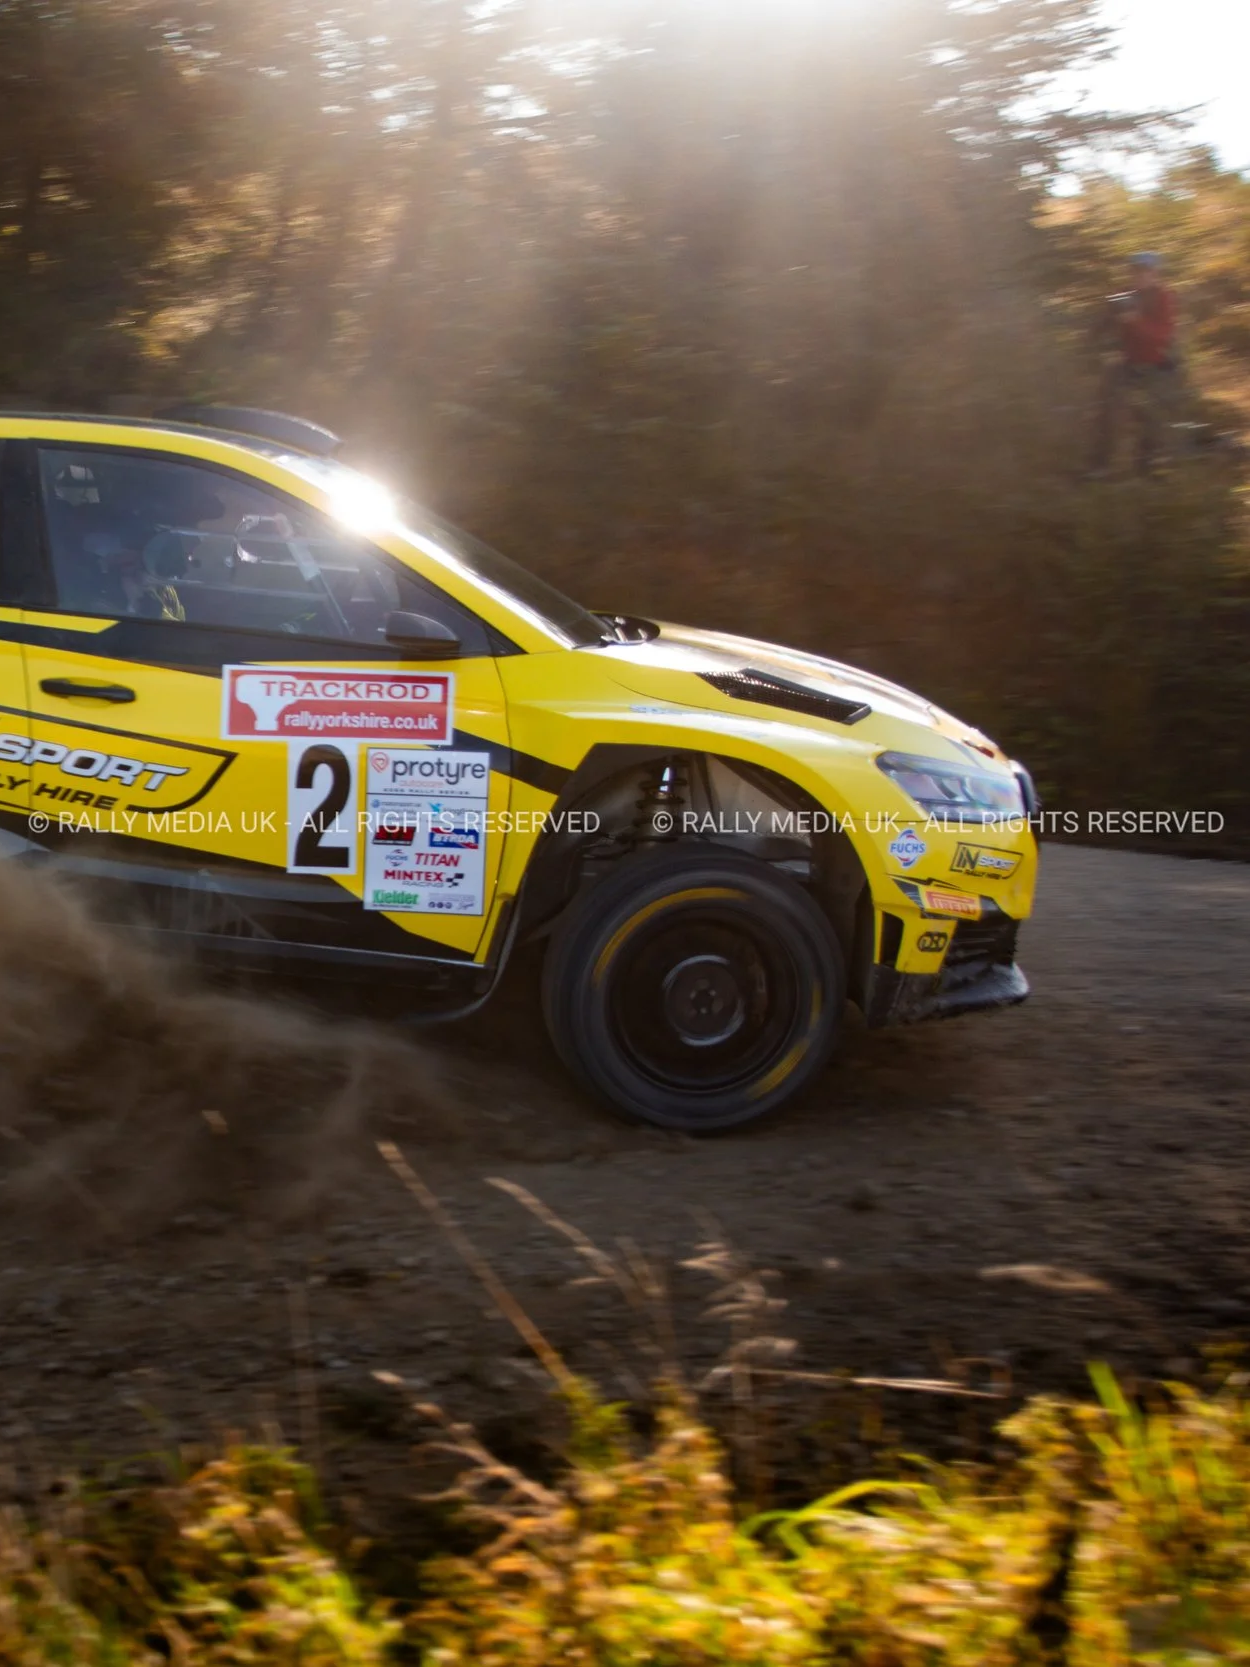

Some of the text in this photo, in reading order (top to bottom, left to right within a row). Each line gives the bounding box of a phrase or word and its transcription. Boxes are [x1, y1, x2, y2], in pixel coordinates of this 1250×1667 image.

[259, 680, 430, 700] TRACKROD
[284, 711, 438, 731] rallyyorkshire.co.uk
[391, 757, 486, 786] protyre
[34, 783, 119, 811] HIRE
[294, 743, 351, 868] 2
[889, 842, 926, 854] FUCHS
[414, 852, 461, 867] TITAN
[383, 869, 445, 882] MINTEX
